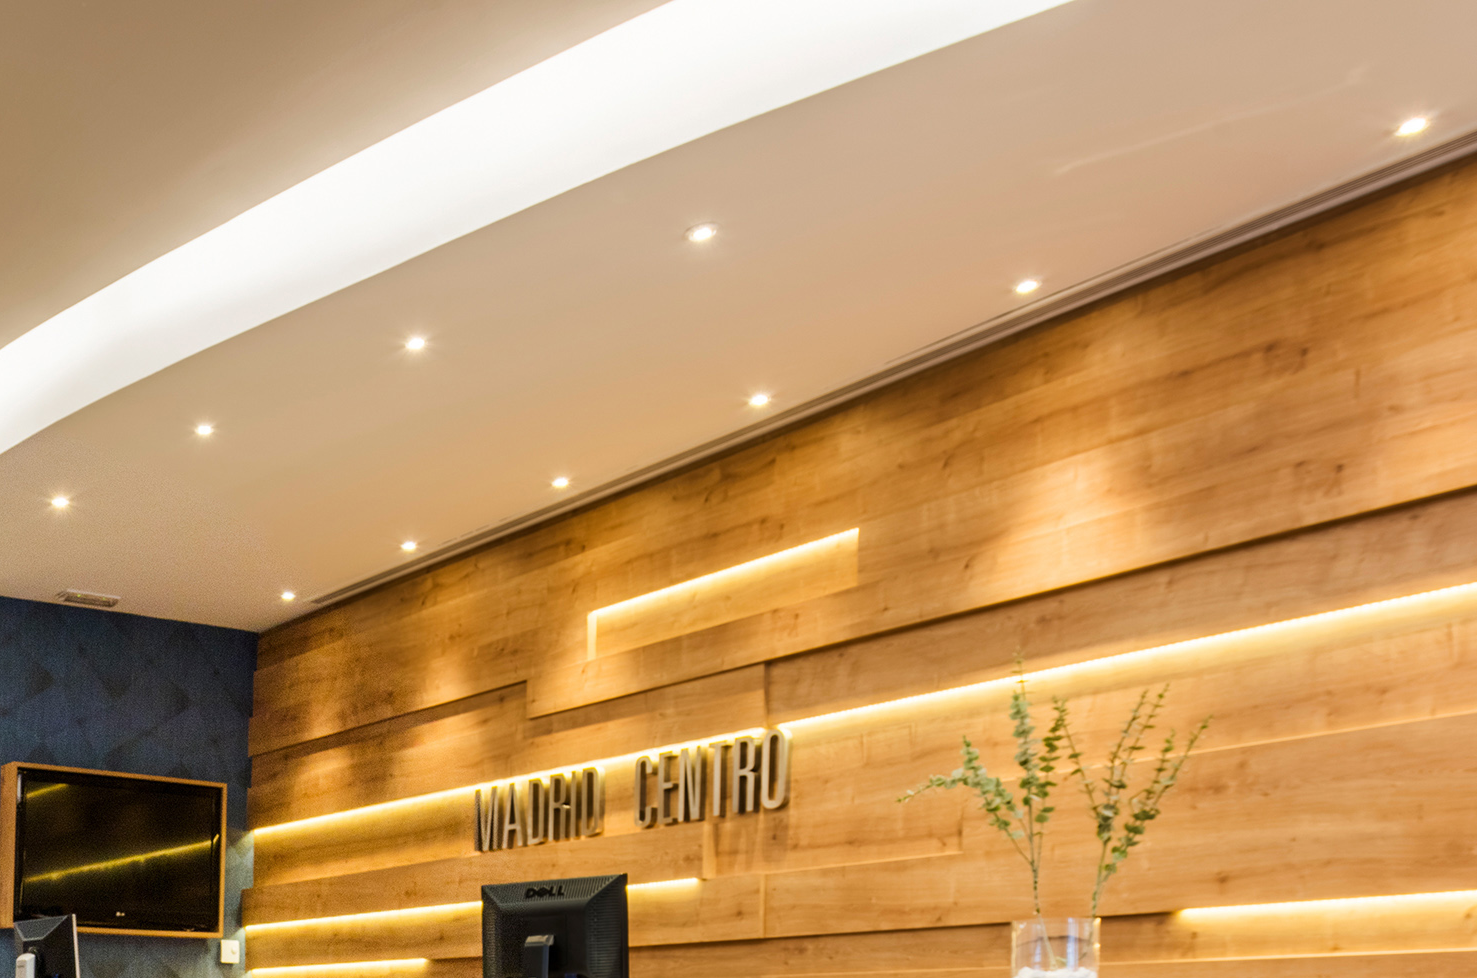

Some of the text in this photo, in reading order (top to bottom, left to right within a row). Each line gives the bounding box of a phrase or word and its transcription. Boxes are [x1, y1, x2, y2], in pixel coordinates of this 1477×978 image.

[474, 729, 788, 852] MADRID CENTRO
[525, 885, 564, 899] DELL
